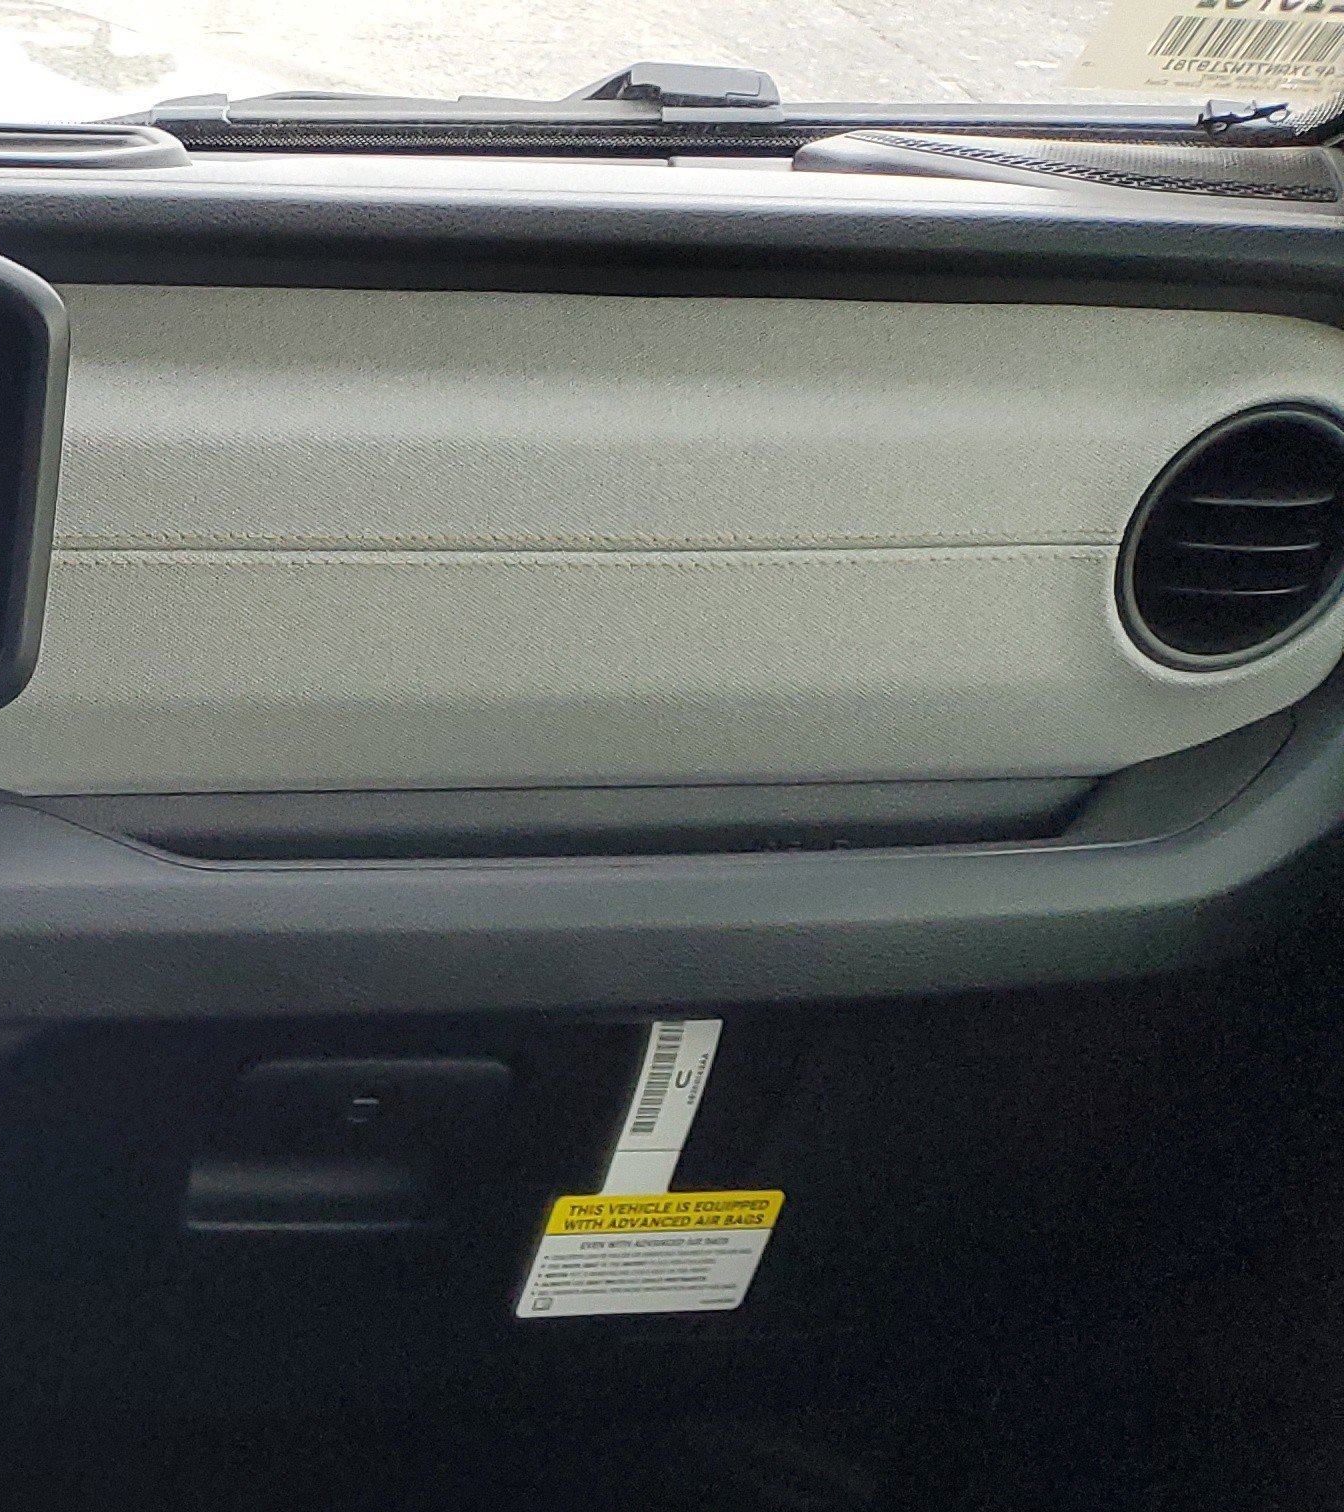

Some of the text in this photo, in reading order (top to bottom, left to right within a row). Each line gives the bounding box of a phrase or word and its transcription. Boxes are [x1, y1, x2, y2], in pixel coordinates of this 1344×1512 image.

[568, 1199, 771, 1217] THIS VEHICLE IS EQUIPPED
[564, 1213, 765, 1231] WITH ADVANCED AIR BAGS
